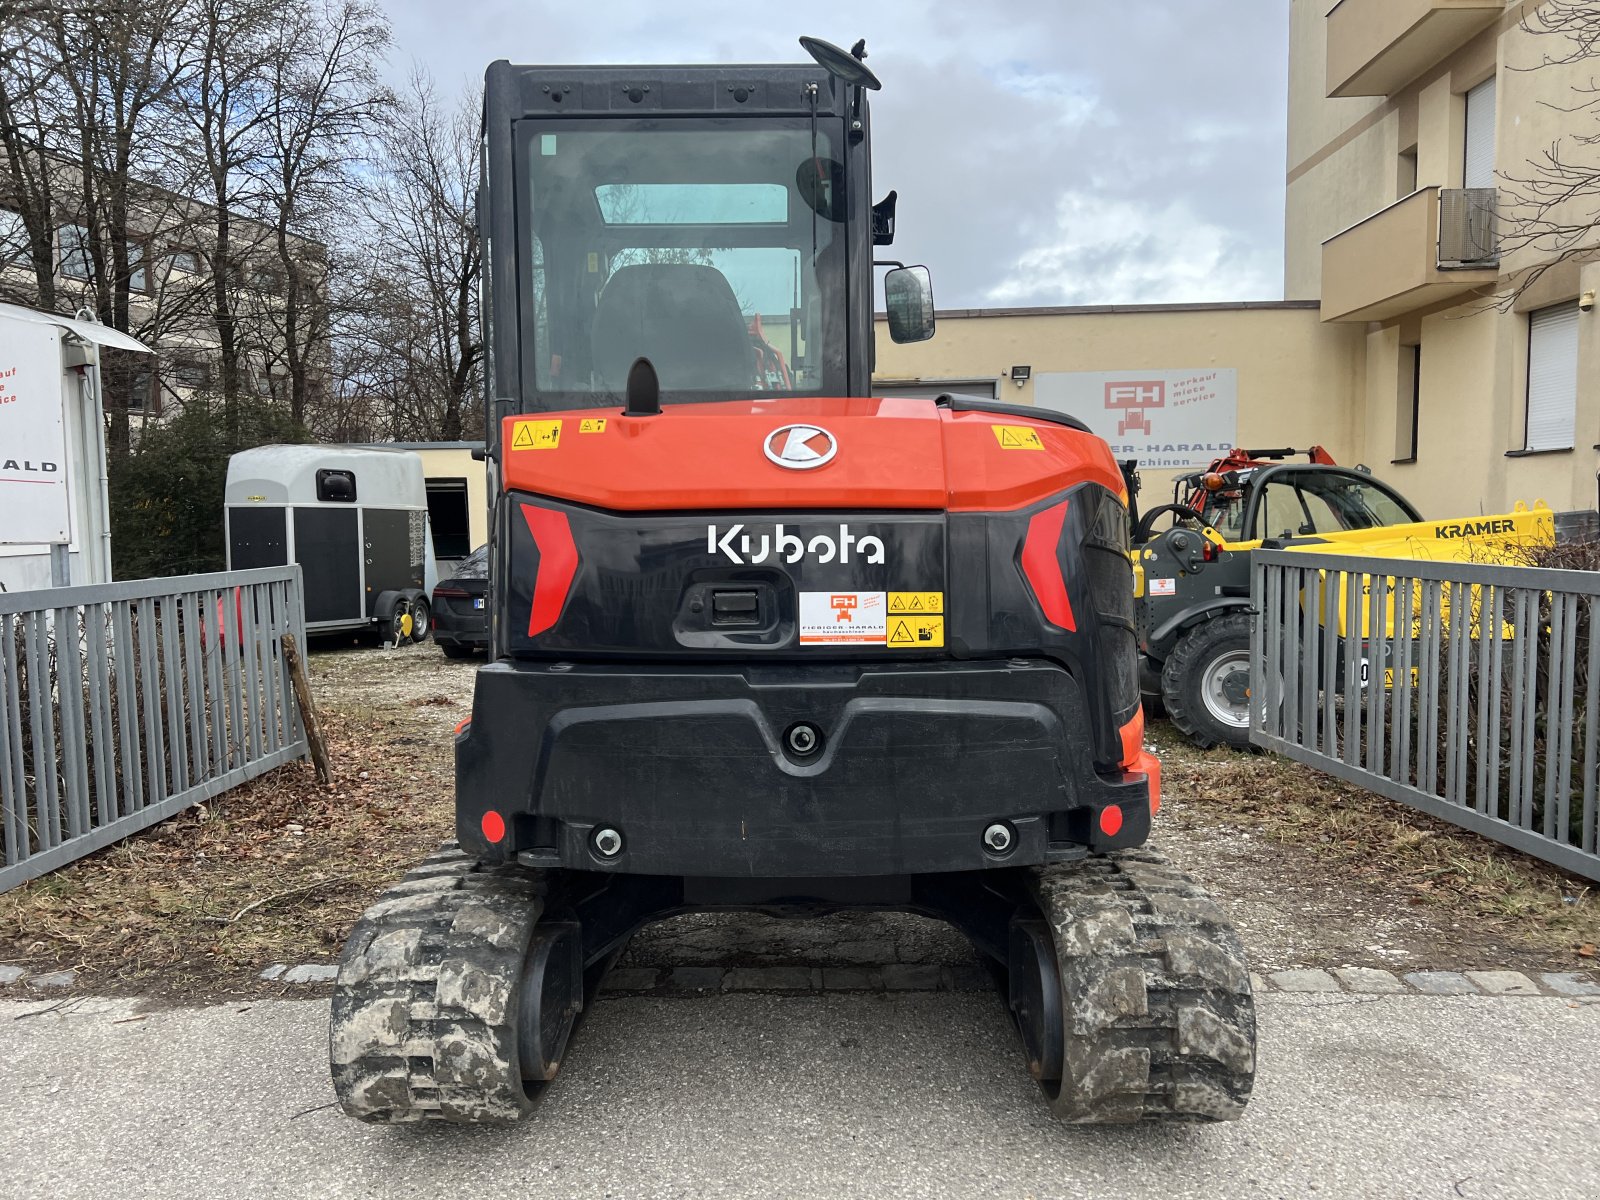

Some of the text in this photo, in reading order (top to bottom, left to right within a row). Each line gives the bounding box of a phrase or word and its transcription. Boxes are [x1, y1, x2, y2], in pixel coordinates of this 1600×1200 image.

[1173, 372, 1216, 388] verkauf
[1110, 386, 1160, 403] FH
[1173, 386, 1206, 398] miete
[1173, 393, 1216, 407] service
[1435, 519, 1516, 539] KRAMER
[707, 524, 885, 565] Kubota
[833, 597, 856, 607] FH
